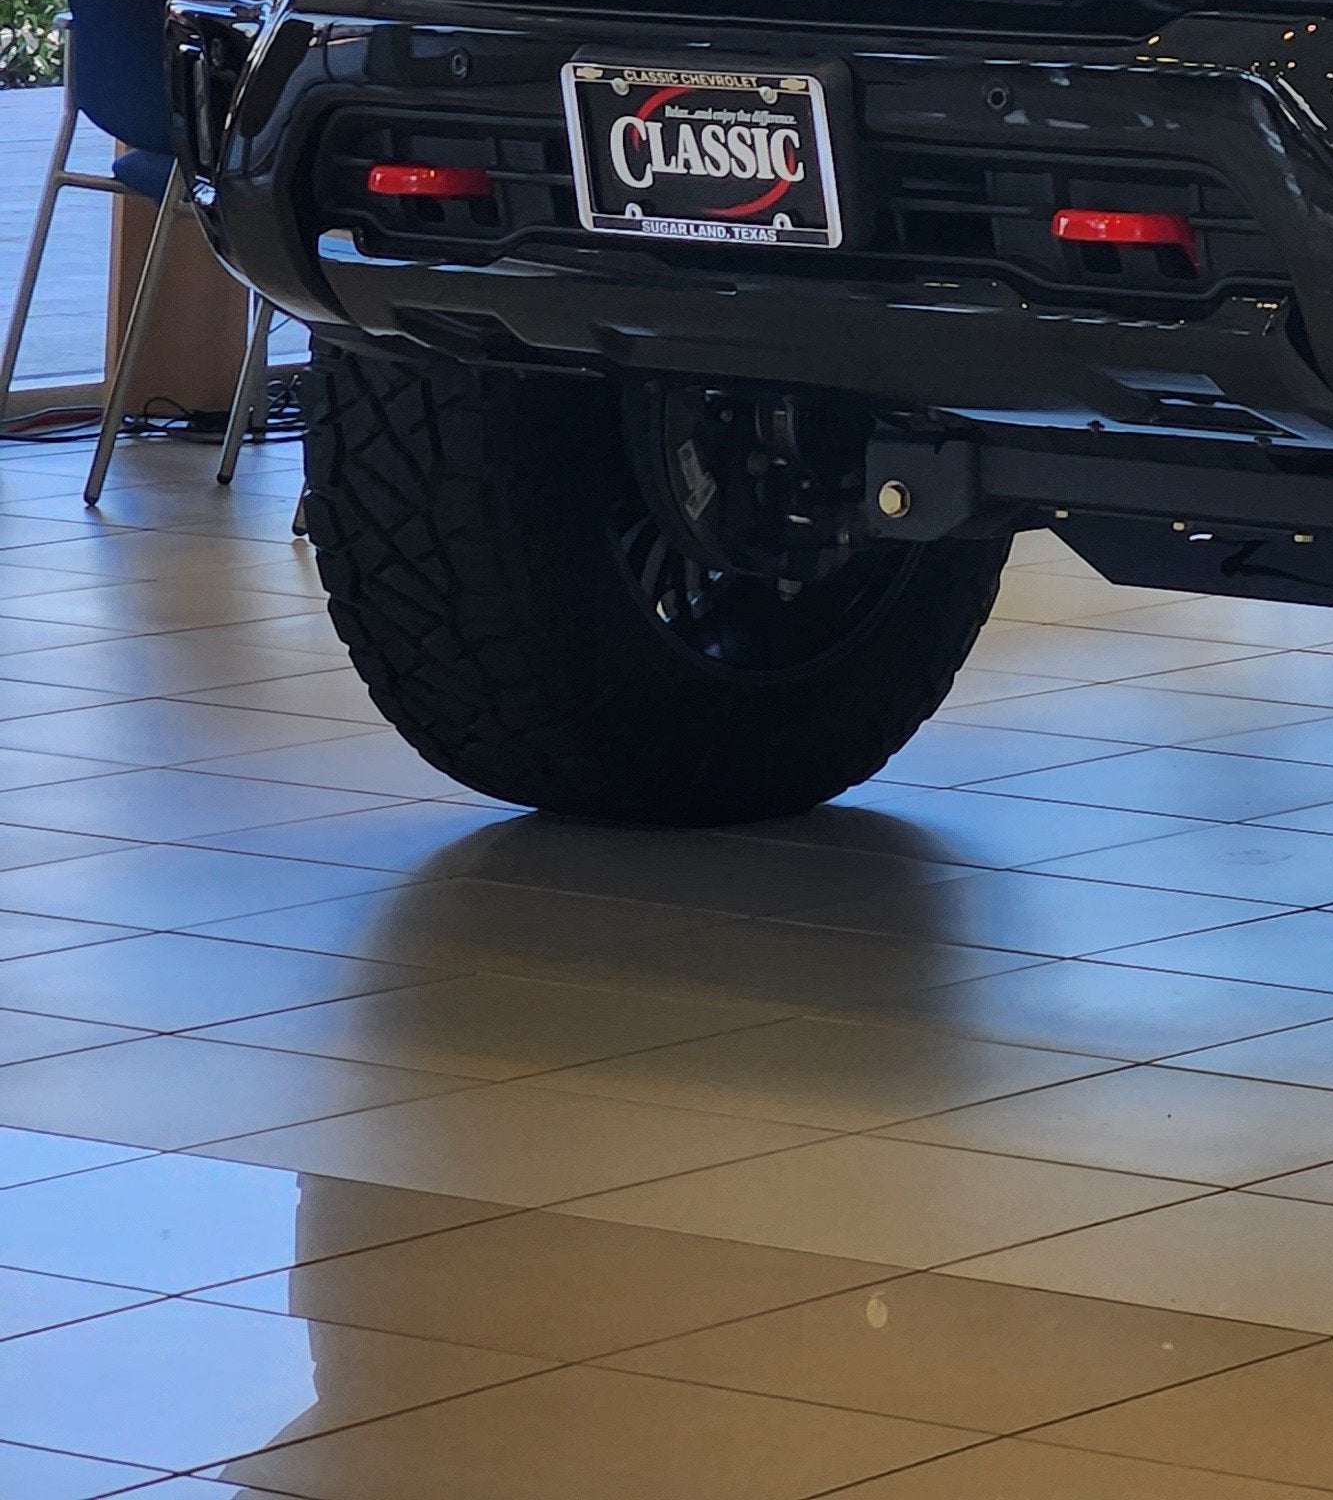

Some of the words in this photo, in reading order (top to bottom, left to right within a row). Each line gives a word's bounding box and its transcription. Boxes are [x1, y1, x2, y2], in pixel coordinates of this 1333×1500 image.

[623, 69, 678, 85] CLASSIC
[680, 73, 759, 88] CHEVROLET
[610, 115, 805, 189] CLASSIC
[641, 220, 688, 237] SUGAR
[689, 224, 731, 240] LAND,
[733, 226, 778, 243] TEXAS
